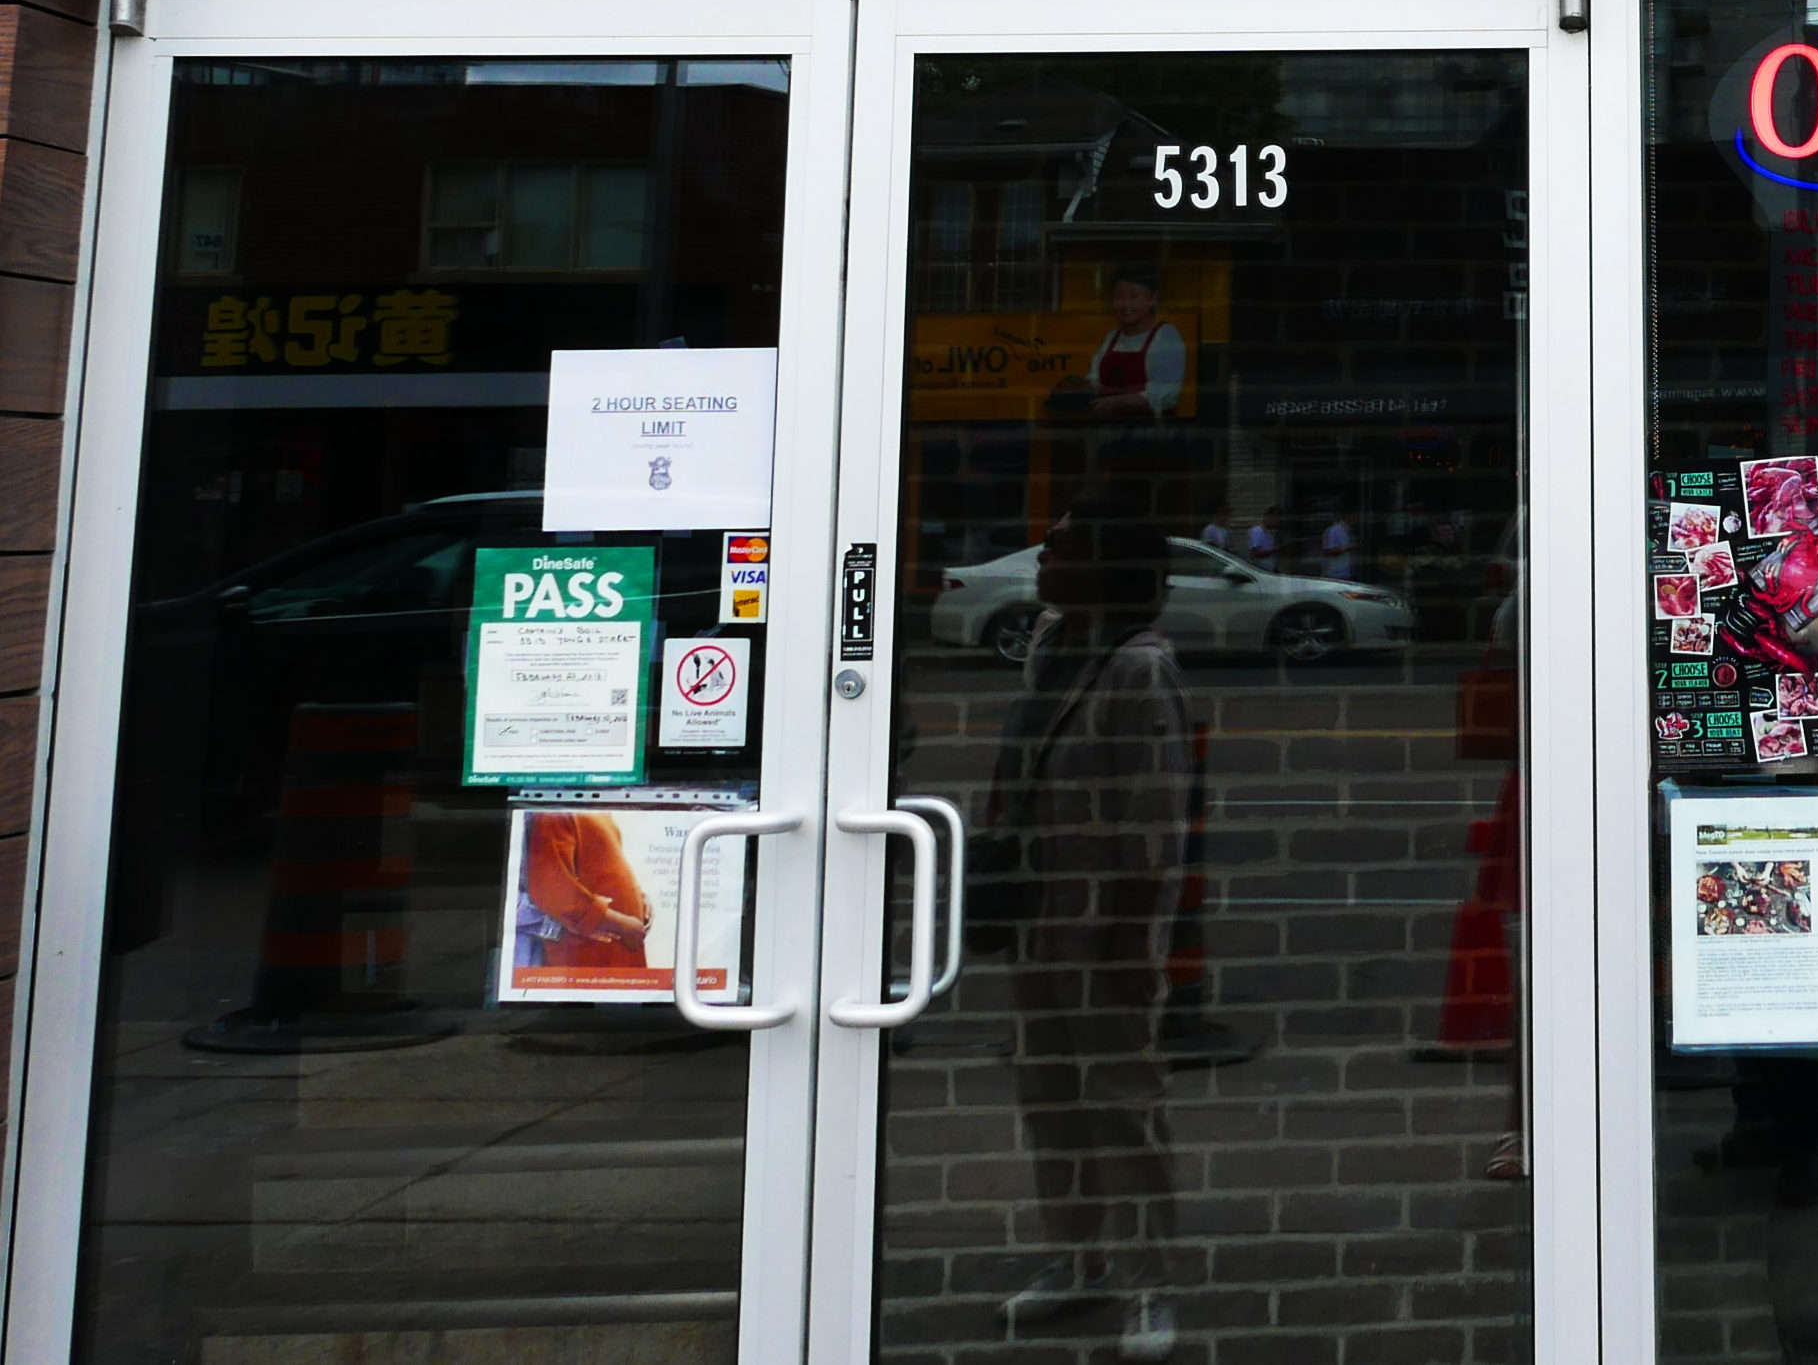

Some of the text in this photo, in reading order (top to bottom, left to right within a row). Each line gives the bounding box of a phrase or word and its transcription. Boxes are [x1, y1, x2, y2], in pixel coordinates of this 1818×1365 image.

[1153, 145, 1289, 209] 5313
[592, 396, 738, 411] 2 HOUR SEATING
[641, 421, 686, 435] LIMIT
[1681, 472, 1713, 485] CHOOSE
[532, 555, 595, 570] DineSafe
[731, 570, 766, 584] VISA
[502, 572, 625, 619] PASS
[852, 570, 866, 638] PULL
[1673, 664, 1707, 676] CHOOSE
[1655, 670, 1668, 689] 2
[1708, 713, 1741, 725] CHOOSE
[1690, 719, 1704, 738] 3
